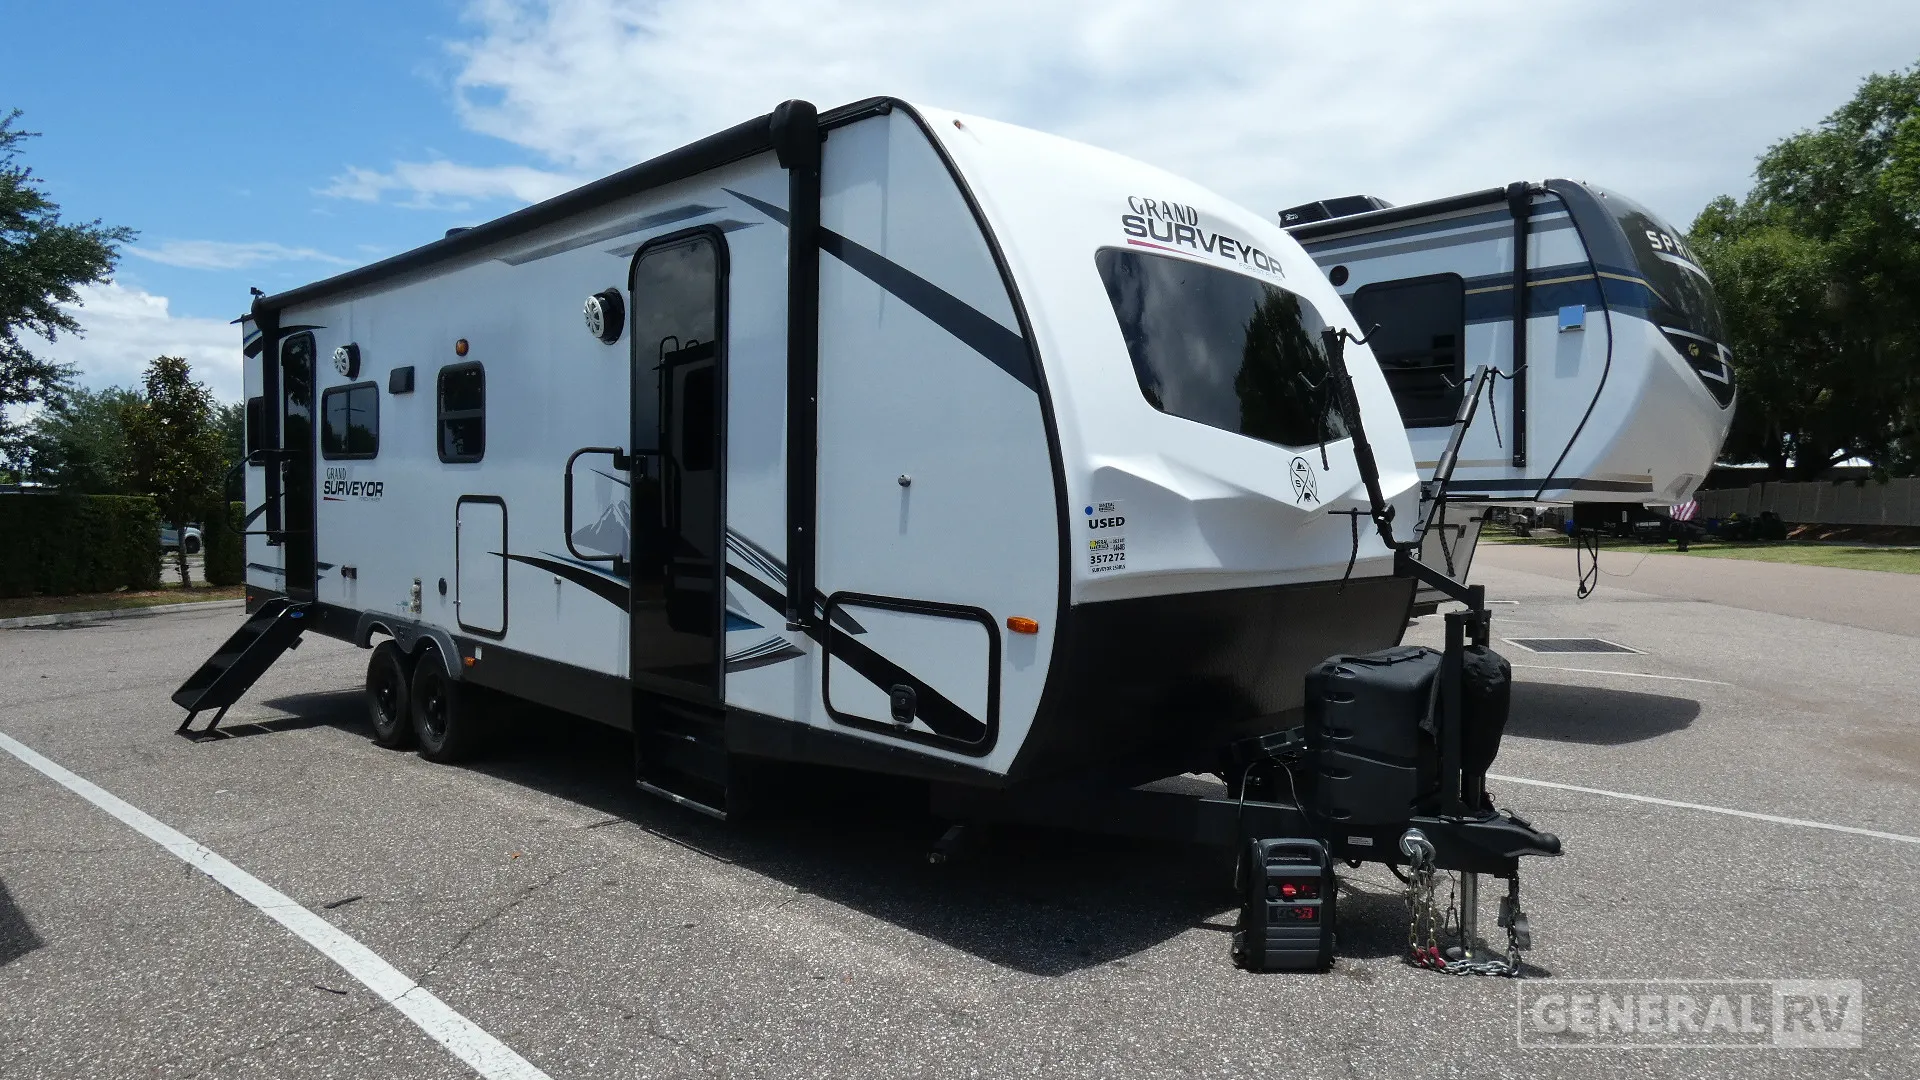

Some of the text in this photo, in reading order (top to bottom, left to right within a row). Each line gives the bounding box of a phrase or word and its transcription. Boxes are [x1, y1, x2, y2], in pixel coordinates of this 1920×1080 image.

[1127, 195, 1199, 227] GRAND
[1121, 214, 1286, 279] SURVEYOR
[326, 467, 347, 480] GRAND
[323, 480, 384, 497] SURVEYOR
[1088, 516, 1125, 529] USED
[1090, 552, 1125, 565] 357272
